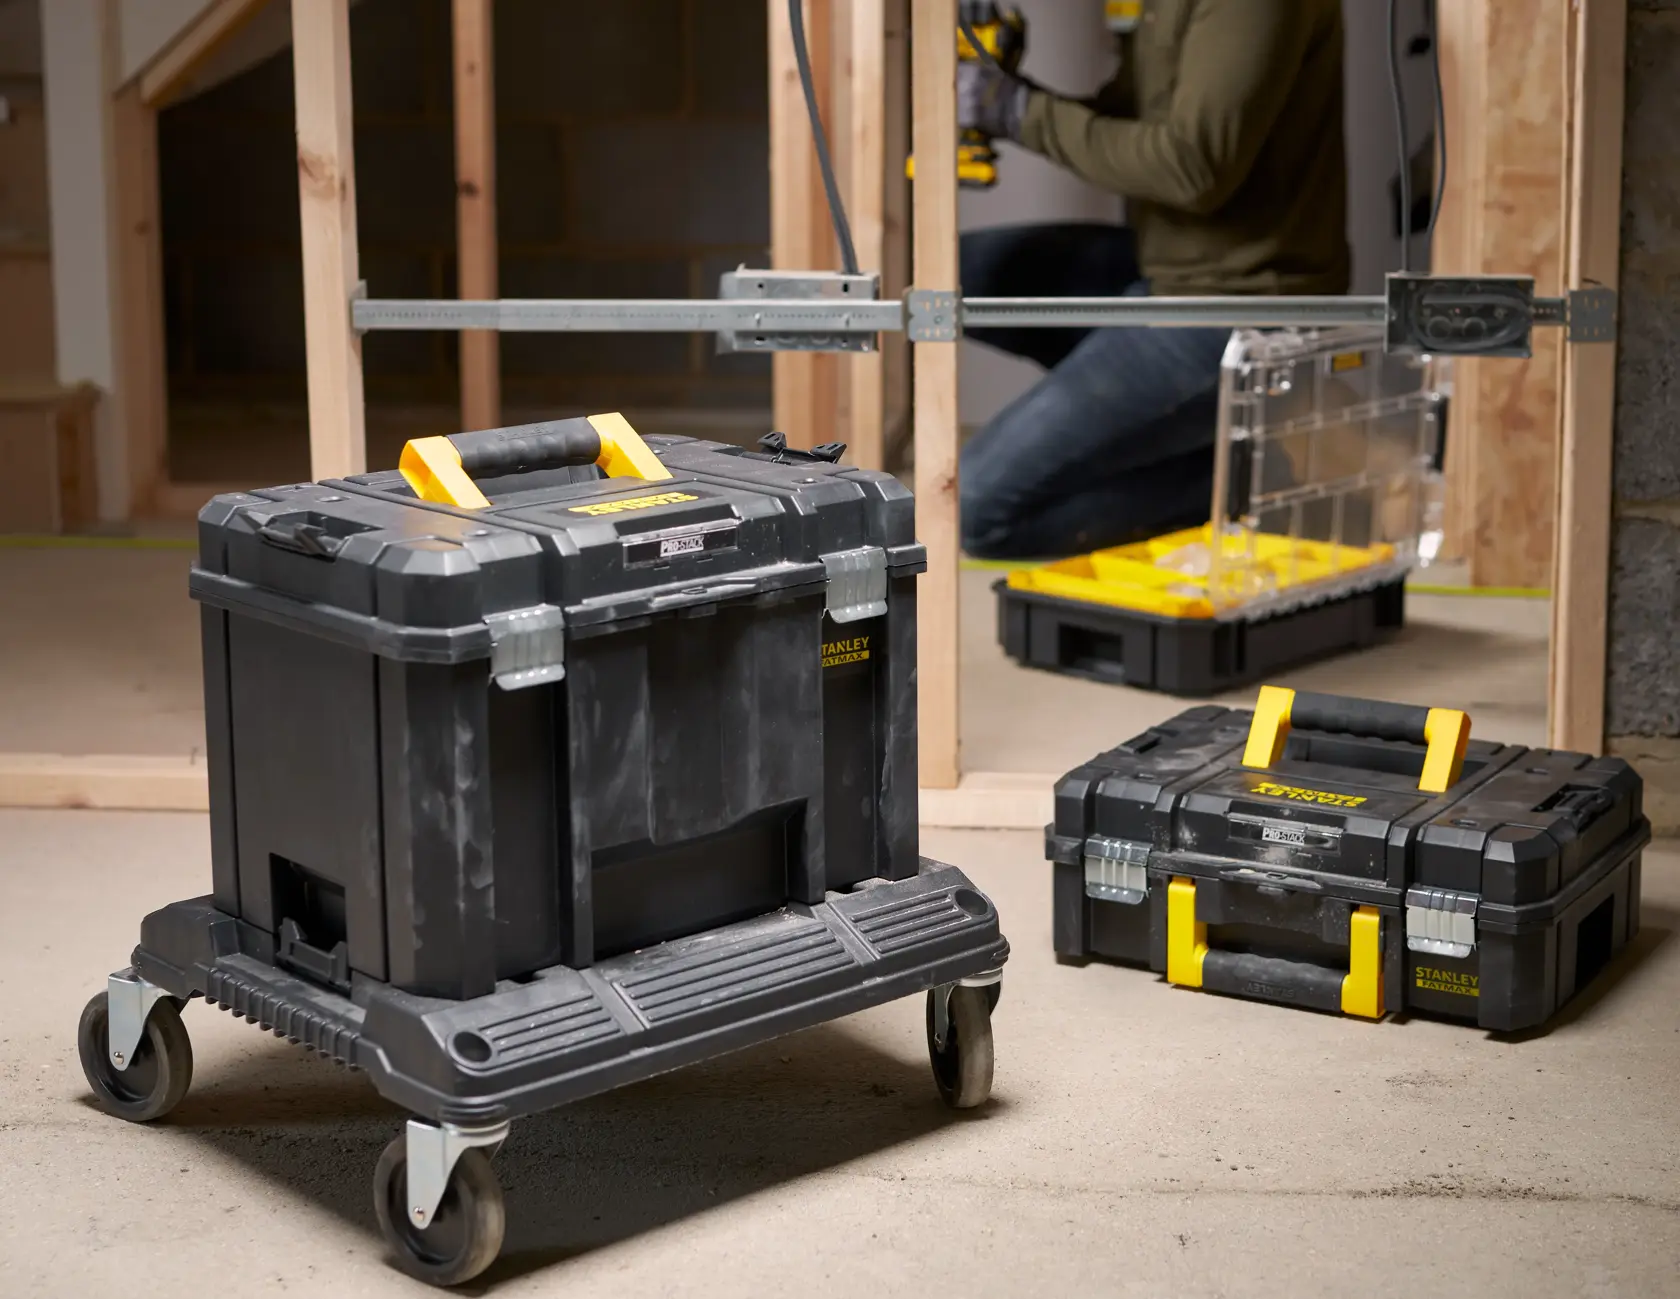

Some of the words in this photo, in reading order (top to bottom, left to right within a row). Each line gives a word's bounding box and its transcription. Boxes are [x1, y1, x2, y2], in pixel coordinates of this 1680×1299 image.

[661, 536, 704, 555] PRO-STACK
[822, 636, 870, 656] TANLEY
[822, 651, 865, 667] ATMAX
[1250, 786, 1359, 807] STANLEY
[1262, 827, 1305, 844] PRO-STACK
[1416, 966, 1479, 987] STANLEY
